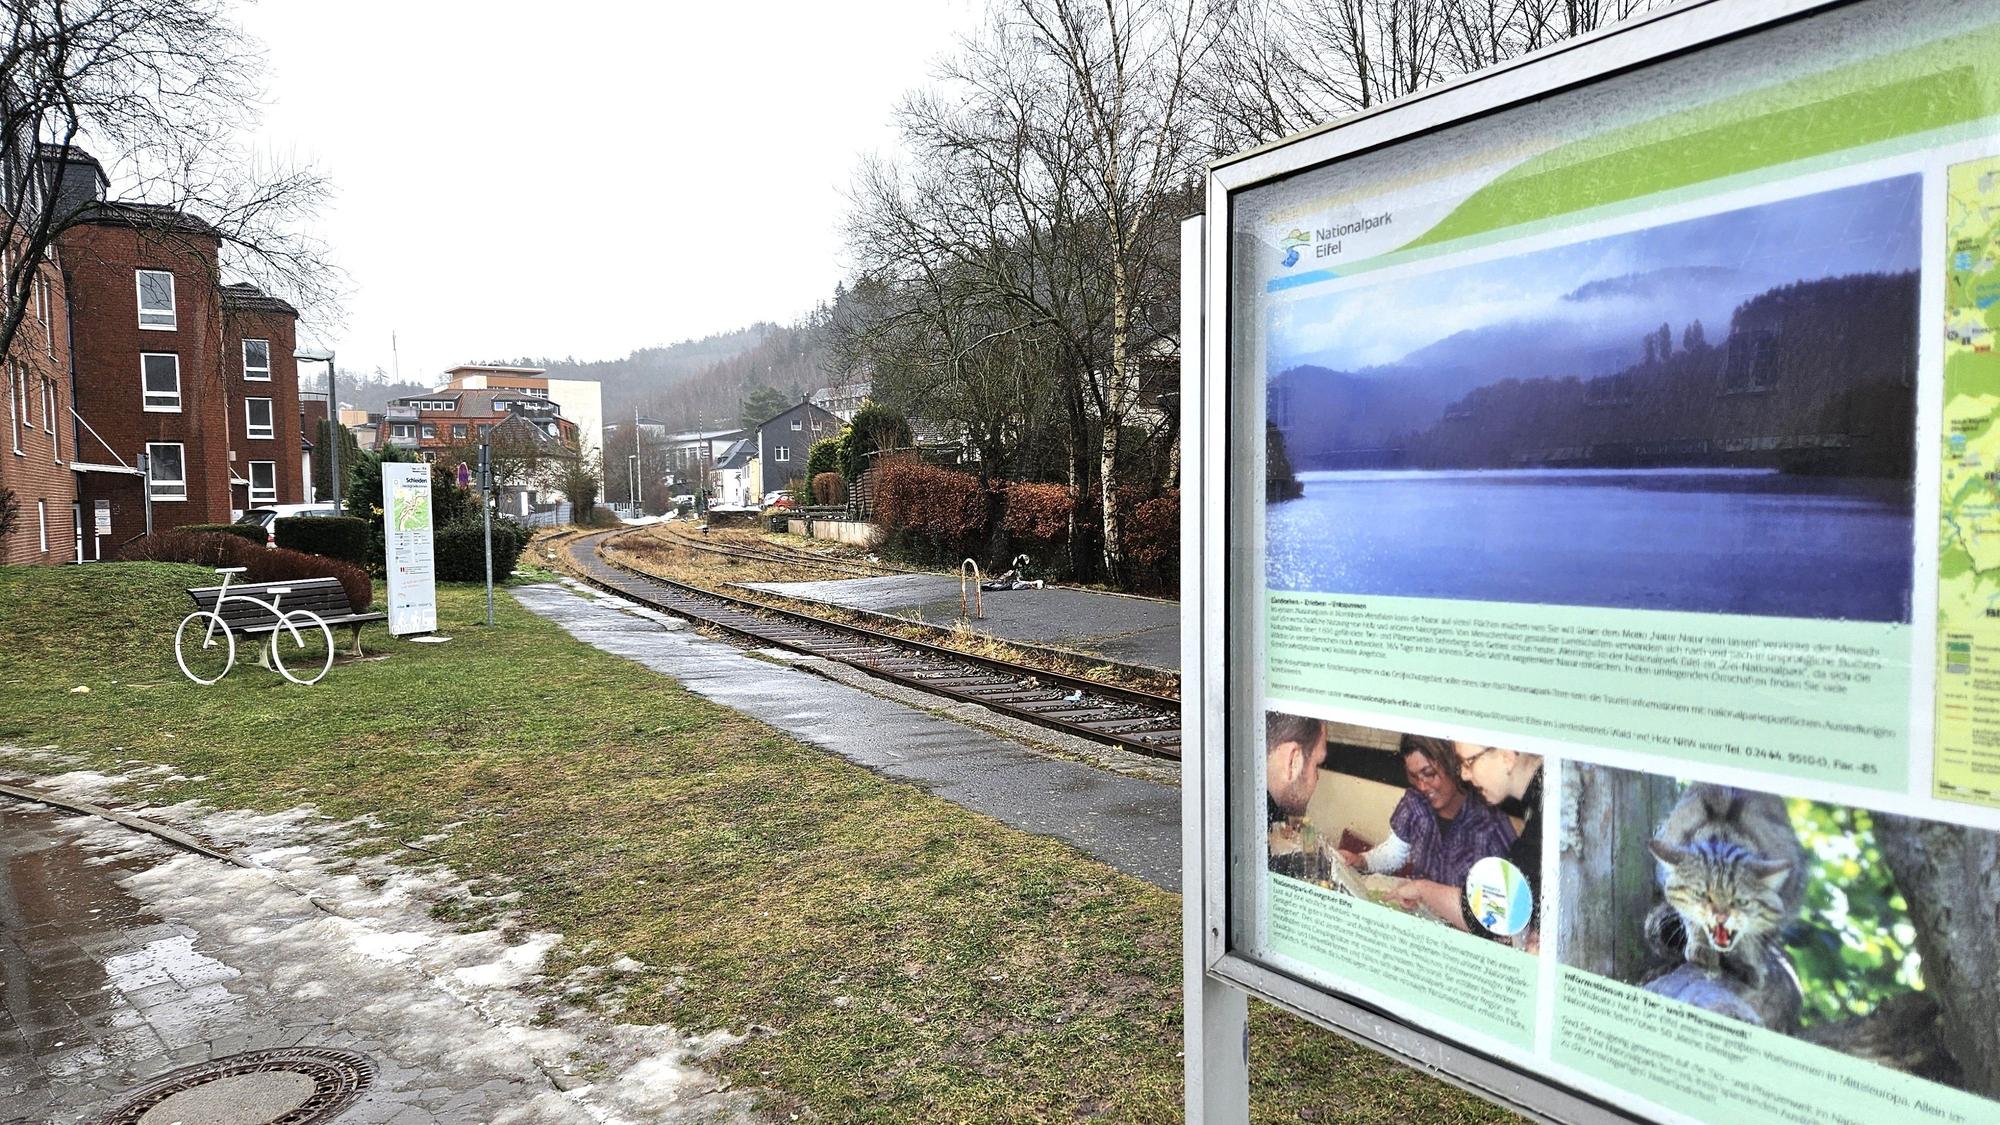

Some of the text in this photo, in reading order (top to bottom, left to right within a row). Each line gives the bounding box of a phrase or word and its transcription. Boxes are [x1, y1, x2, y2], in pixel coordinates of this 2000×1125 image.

[1316, 212, 1392, 241] Nationalpark
[1316, 241, 1342, 258] Eifel
[1914, 1098, 1946, 1120] Allein
